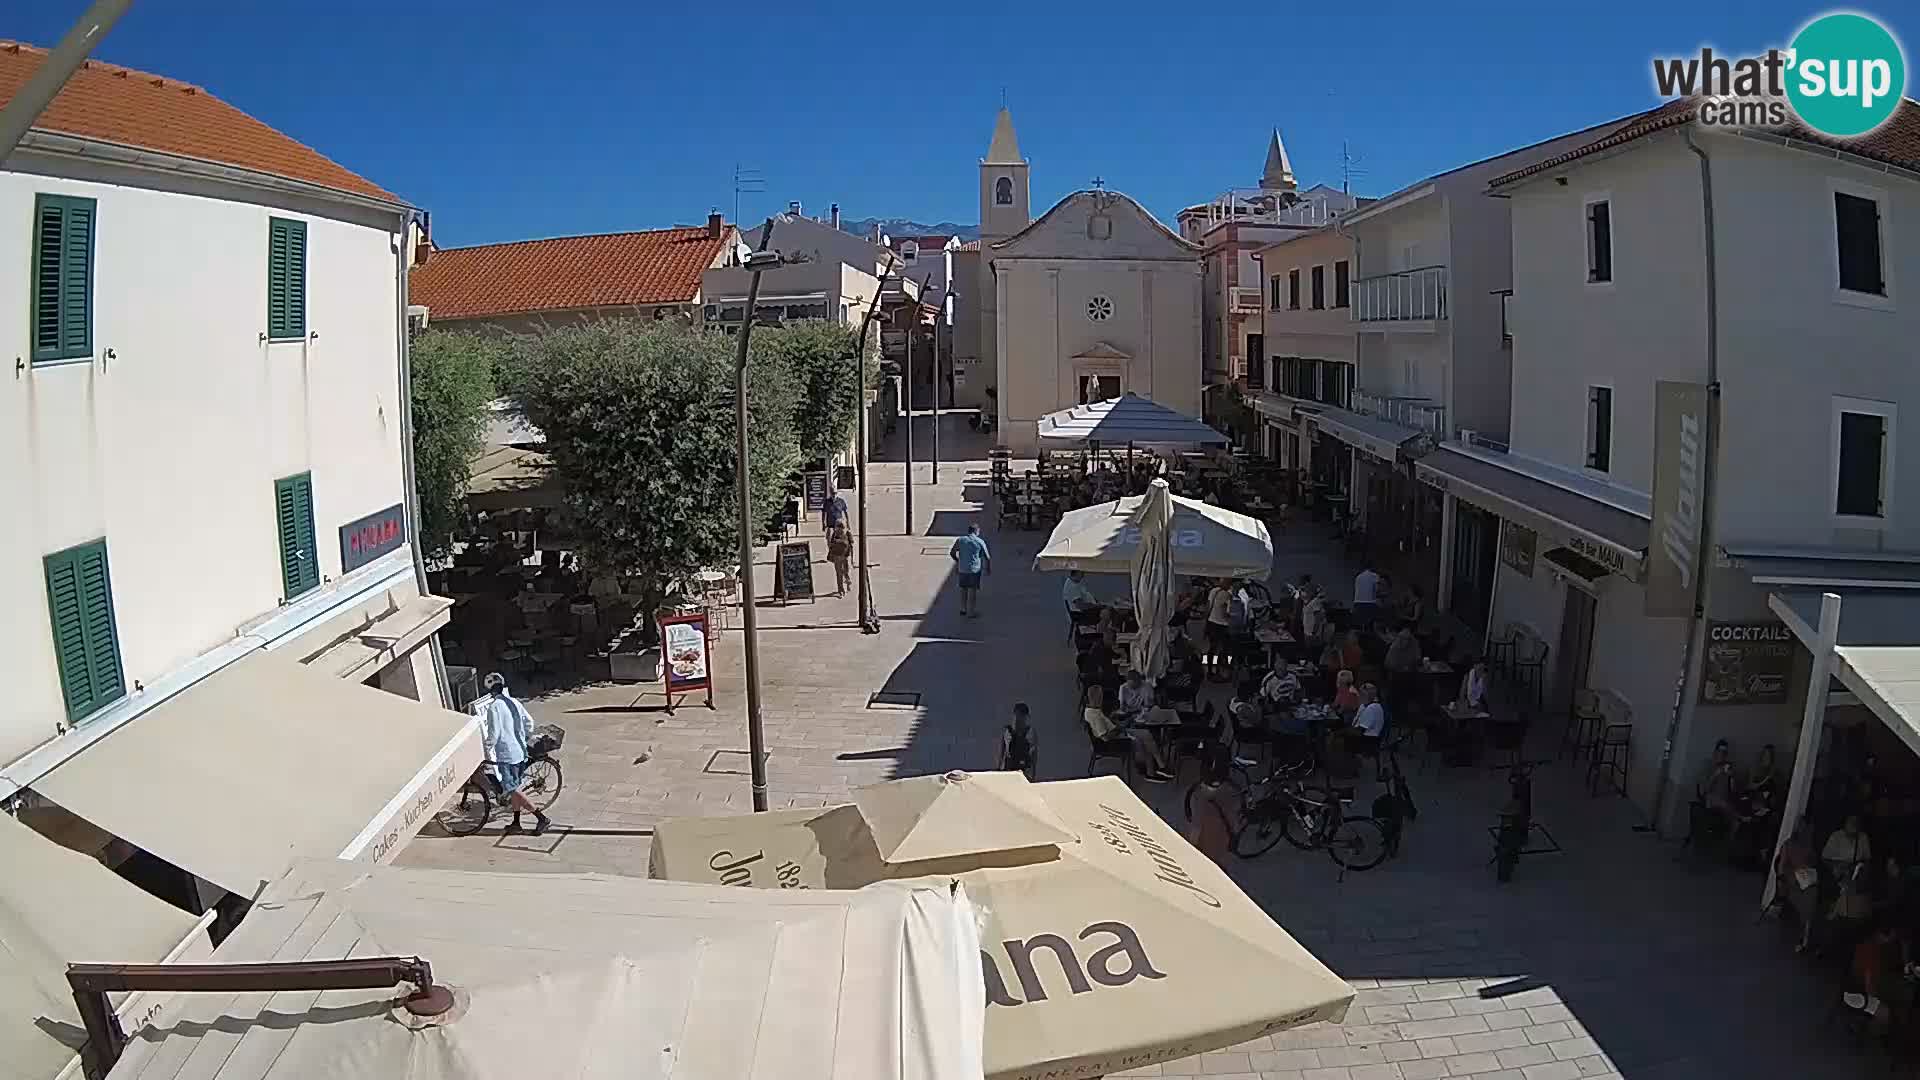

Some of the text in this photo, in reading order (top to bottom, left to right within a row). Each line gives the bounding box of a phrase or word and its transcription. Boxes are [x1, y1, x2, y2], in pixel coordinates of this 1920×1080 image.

[1711, 626, 1791, 641] COCKTAILS
[372, 828, 399, 863] Cakes
[404, 791, 433, 832] Kuchen
[709, 849, 764, 887] Ja
[775, 860, 809, 889] 182
